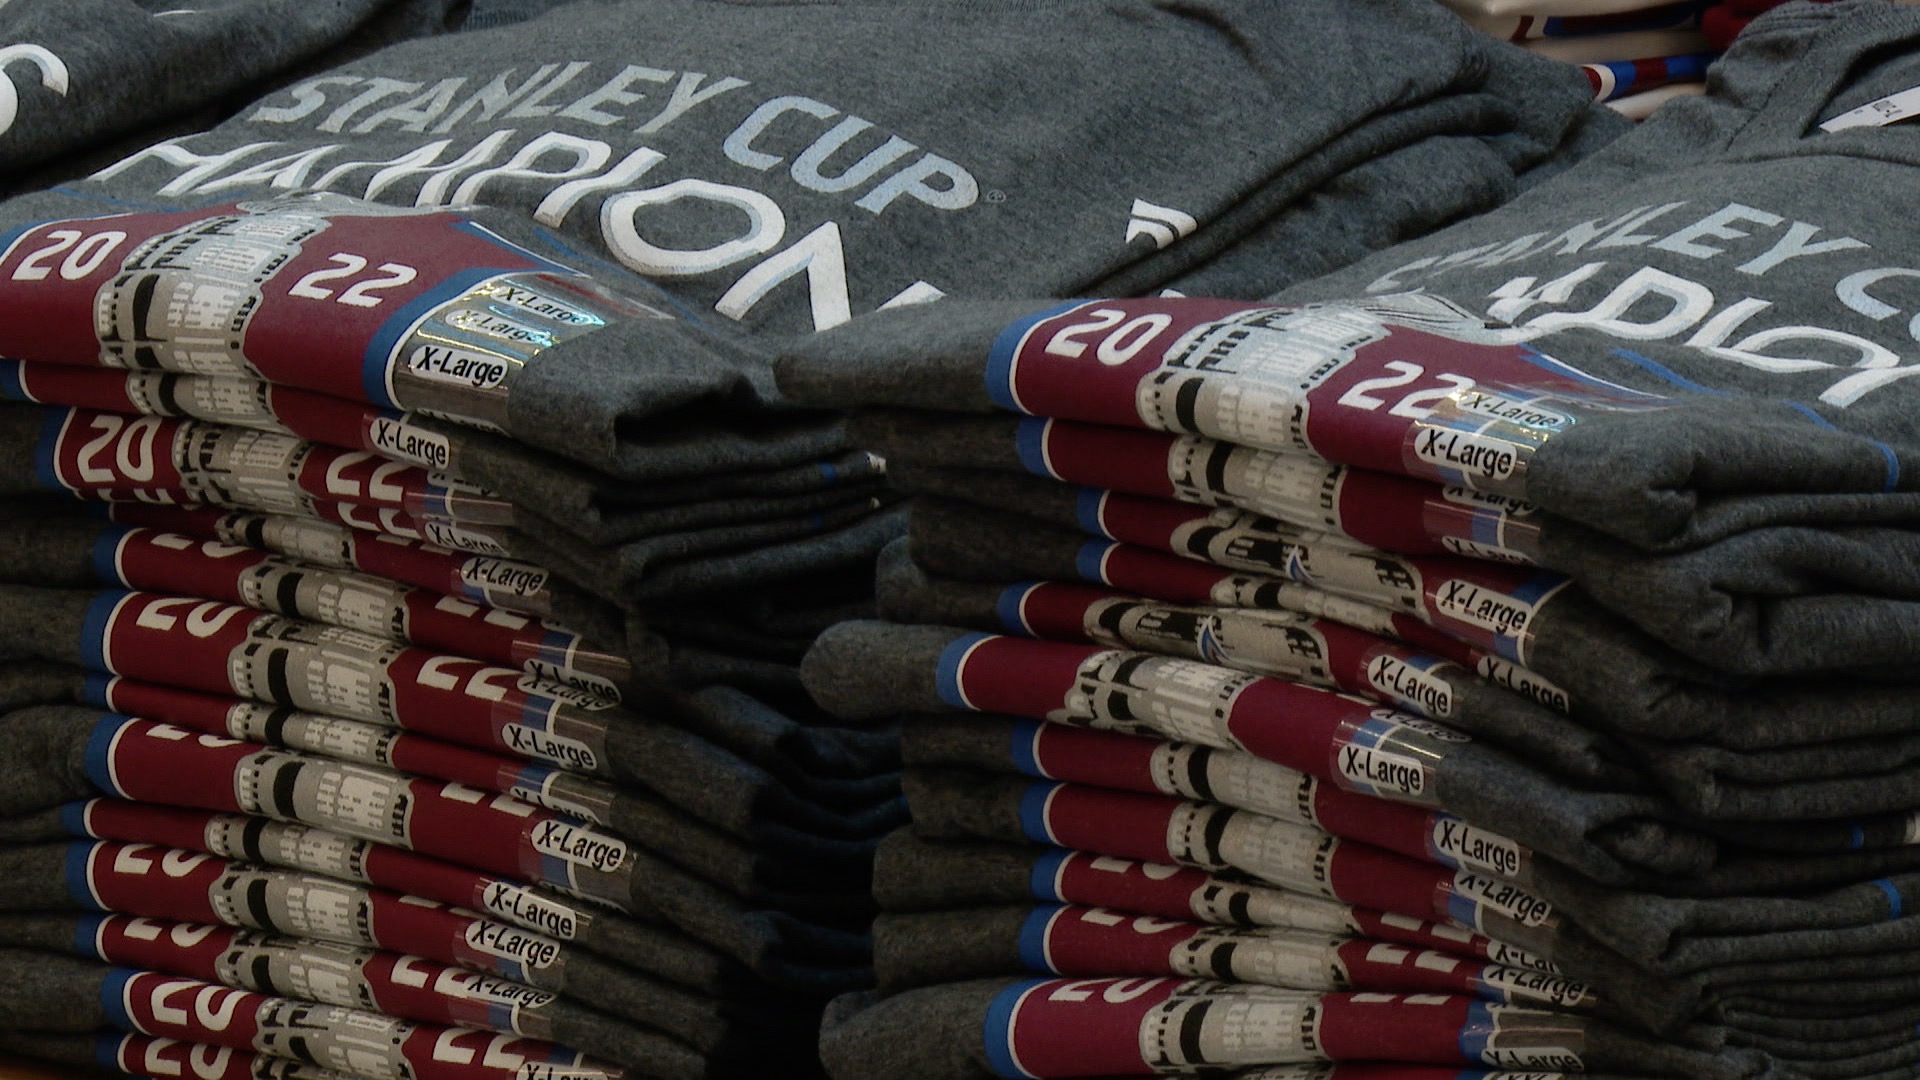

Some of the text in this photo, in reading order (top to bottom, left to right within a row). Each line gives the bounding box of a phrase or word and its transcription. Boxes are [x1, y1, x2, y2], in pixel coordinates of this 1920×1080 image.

[248, 61, 979, 215] STANLEY CUP
[11, 230, 417, 307] 20 22
[500, 286, 591, 325] X-Large
[416, 346, 504, 387] X-Large
[1044, 309, 1475, 420] 20 22
[1465, 392, 1558, 427] X-Large
[76, 414, 163, 483] 20
[377, 420, 446, 465] X-Large
[1421, 429, 1512, 478] X-Large
[466, 557, 543, 595] X-Large
[1443, 581, 1527, 633] X-Large
[1373, 655, 1449, 716] X-Large
[1486, 657, 1567, 710] X-Large
[508, 725, 594, 768] X-Large
[1346, 747, 1421, 792] X-Large
[537, 821, 622, 870] X-Large
[1440, 821, 1517, 876] X-Large
[490, 885, 573, 936] X-Large
[471, 920, 556, 966] X-Large
[467, 974, 554, 1008] X-Large
[1488, 965, 1584, 1002] X-Large
